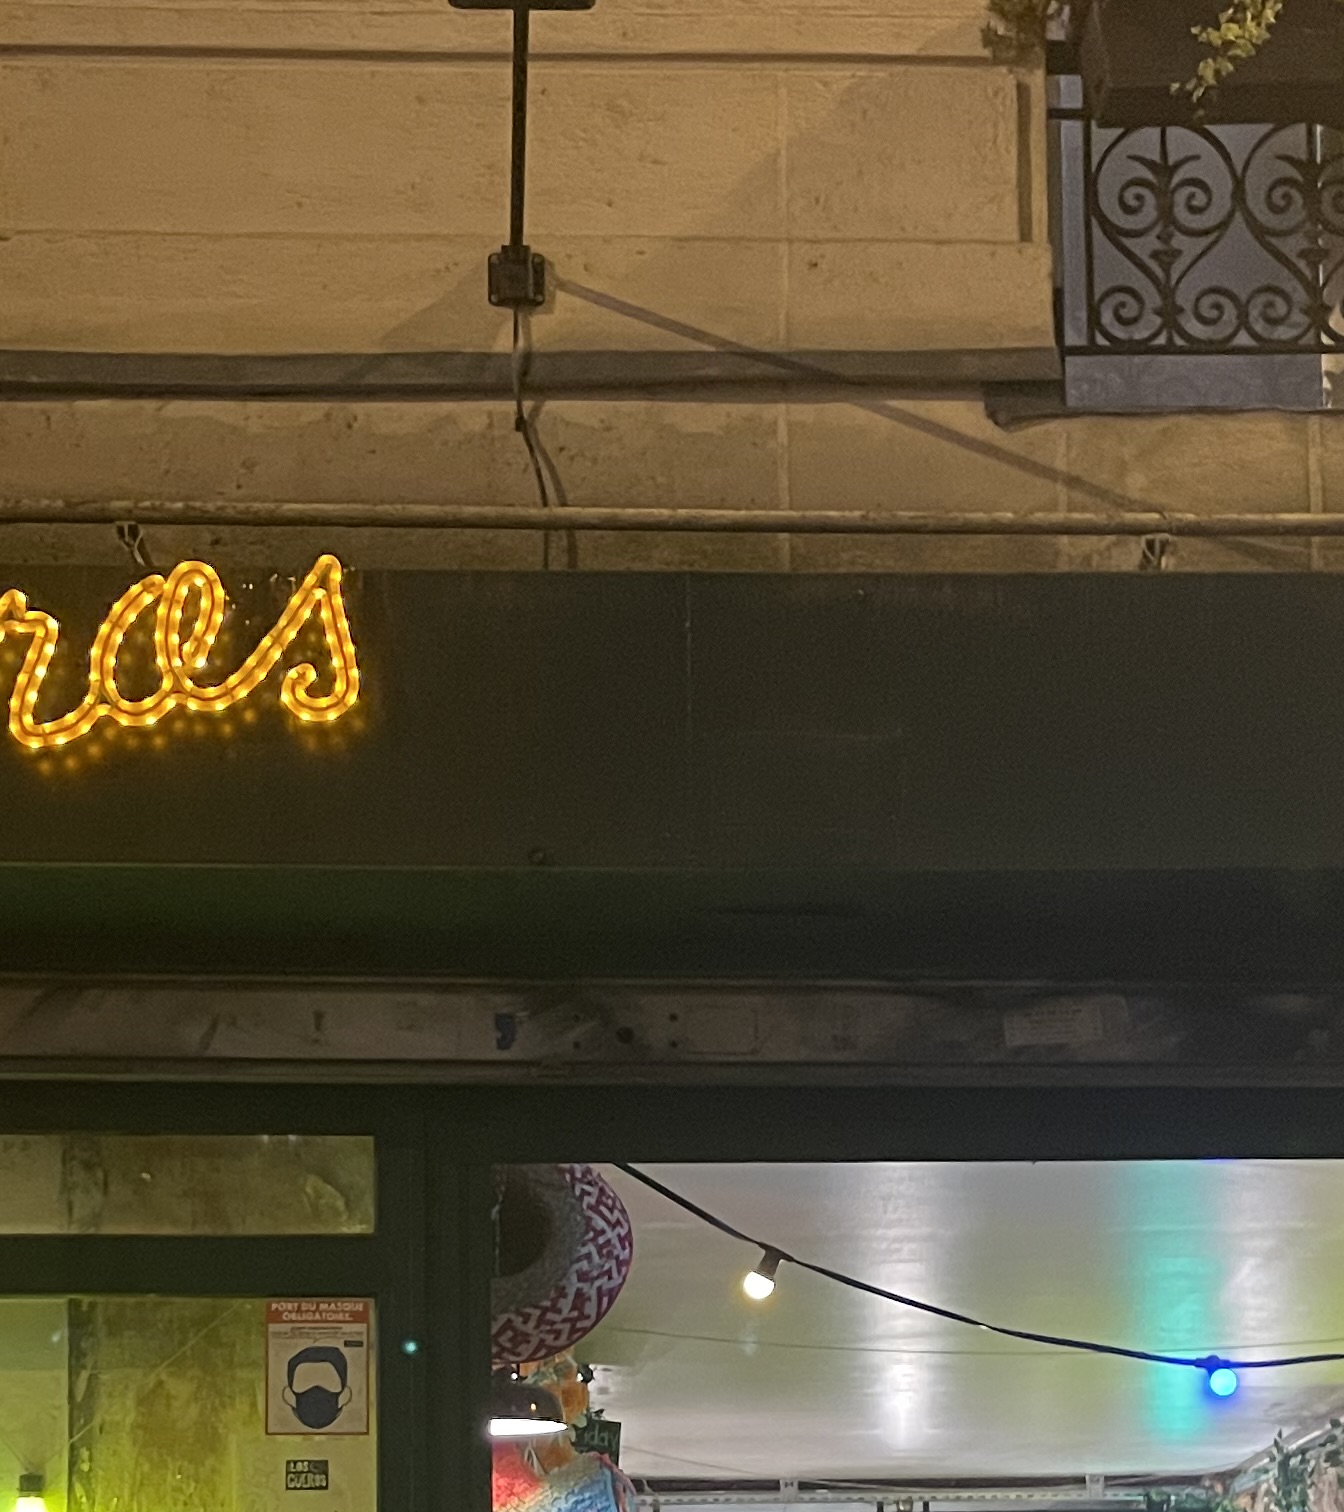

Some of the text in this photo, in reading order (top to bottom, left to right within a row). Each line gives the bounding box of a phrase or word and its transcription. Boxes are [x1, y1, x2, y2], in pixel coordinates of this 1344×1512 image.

[271, 1302, 364, 1312] PORT DU MASQUE
[290, 1461, 309, 1472] LOS
